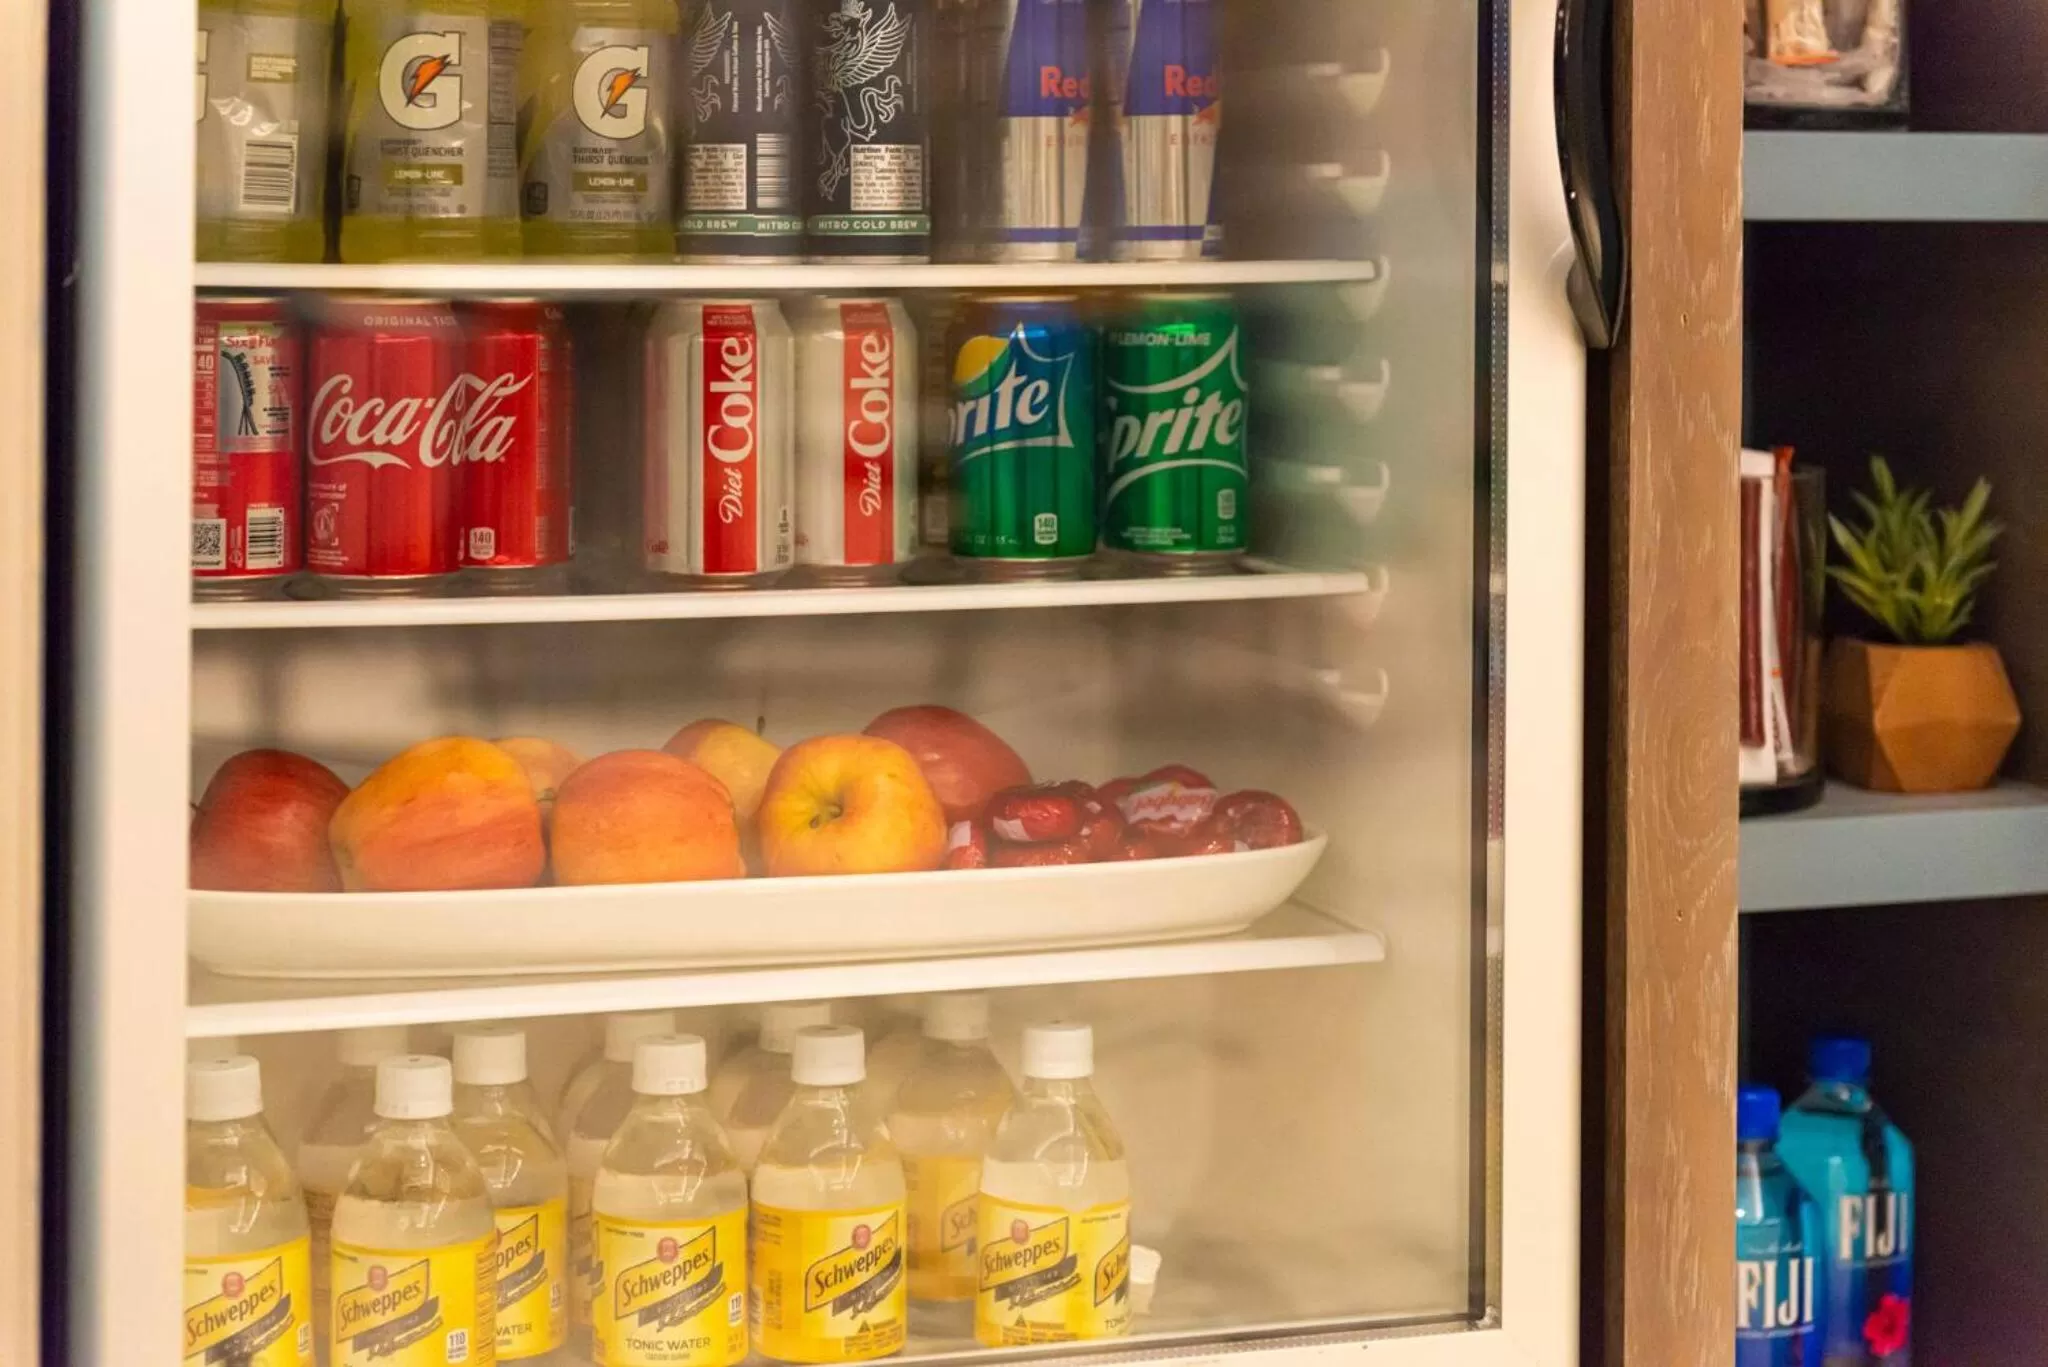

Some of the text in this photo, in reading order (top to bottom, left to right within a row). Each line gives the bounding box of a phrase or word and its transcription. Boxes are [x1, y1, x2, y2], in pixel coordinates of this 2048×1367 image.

[379, 31, 462, 130] G
[572, 45, 650, 139] G
[706, 218, 738, 229] BREW
[818, 219, 918, 230] NITRO COLD BREW
[363, 315, 431, 327] ORIGINAL
[707, 335, 754, 464] Coke
[847, 331, 891, 459] Coke
[948, 358, 1050, 445] rite
[1107, 387, 1243, 473] prite
[718, 467, 744, 525] Diet
[858, 461, 883, 518] Diet
[1838, 1192, 1908, 1261] FIJI
[622, 1247, 711, 1308] Schweppes
[814, 1236, 894, 1299] Schweppes
[983, 1236, 1062, 1281] Schweppes
[186, 1279, 279, 1347] Schweppes
[339, 1279, 423, 1332] Schweppes
[1736, 1257, 1814, 1329] FIJI
[625, 1336, 711, 1350] TONIC WATER
